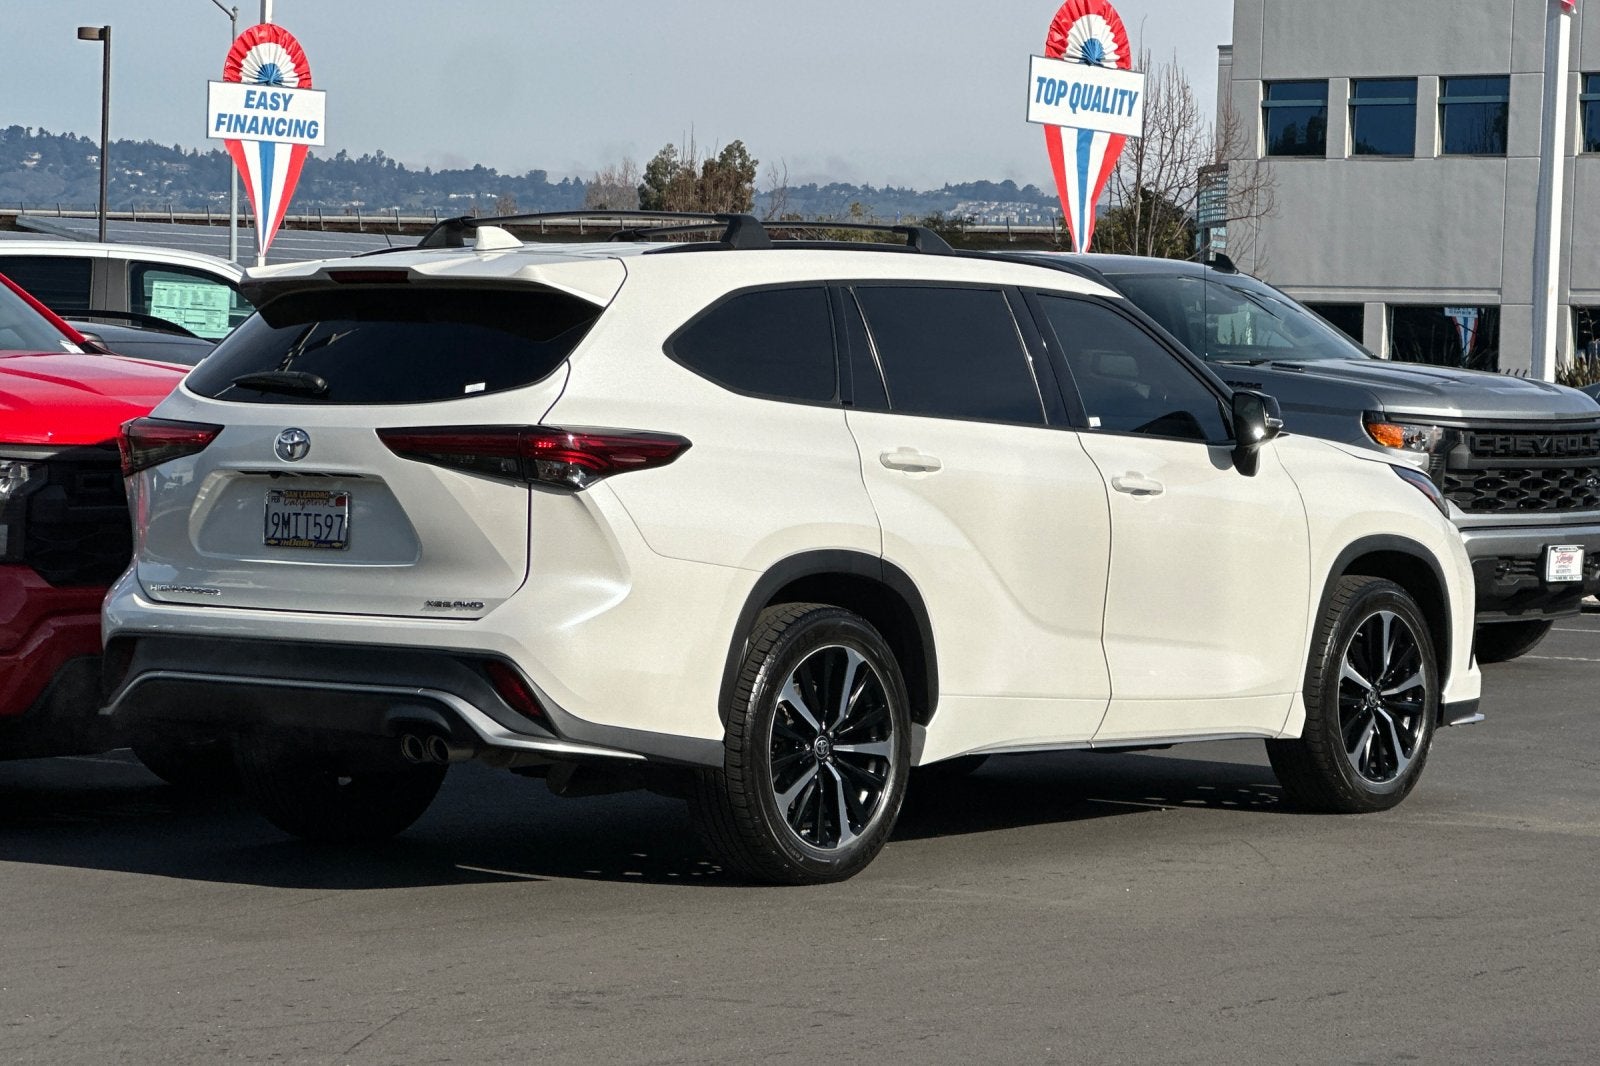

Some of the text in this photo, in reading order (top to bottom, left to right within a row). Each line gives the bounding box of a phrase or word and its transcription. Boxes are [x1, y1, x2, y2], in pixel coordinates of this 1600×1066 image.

[244, 89, 294, 112] EASY
[1035, 75, 1139, 117] TOP QUALITY
[215, 112, 319, 139] FINANCING
[1473, 435, 1600, 454] CHEVROLE
[271, 512, 345, 540] 9MIT597
